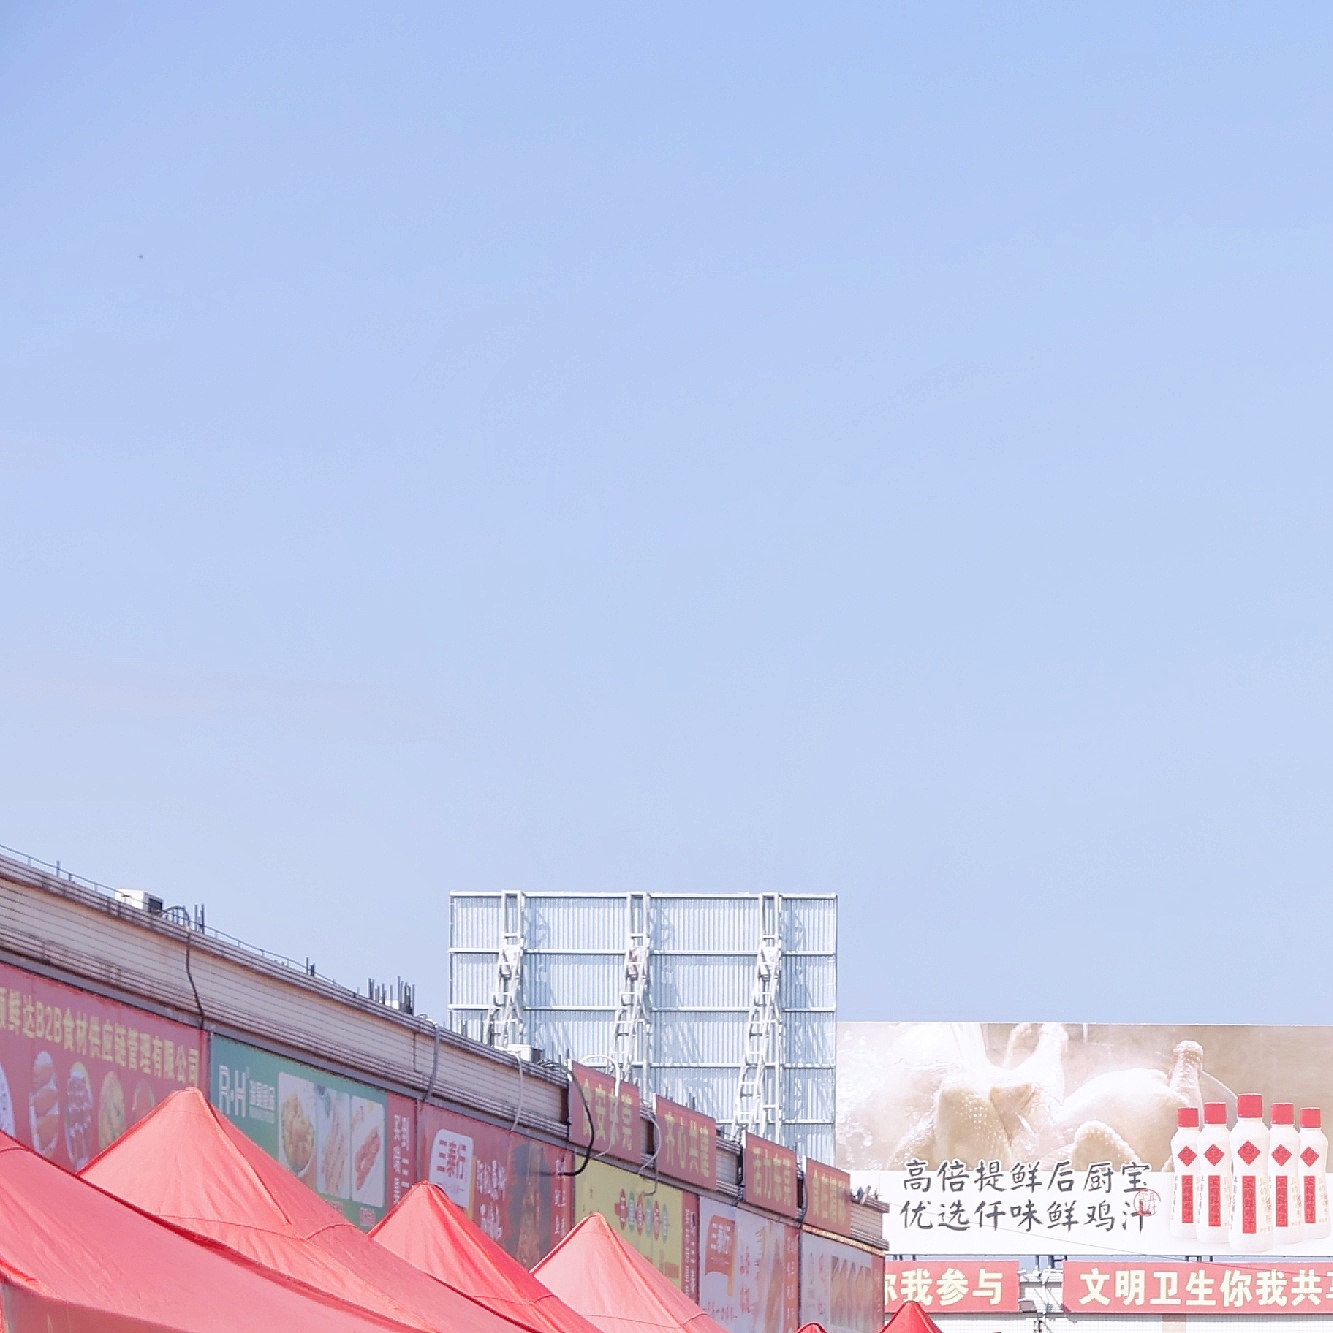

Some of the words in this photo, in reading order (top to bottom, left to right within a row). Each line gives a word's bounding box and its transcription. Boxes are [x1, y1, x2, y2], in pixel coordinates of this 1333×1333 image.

[902, 1159, 1151, 1195] 高倍提鲜后厨宝
[900, 1198, 1148, 1234] 优选仟味鲜鸡汁
